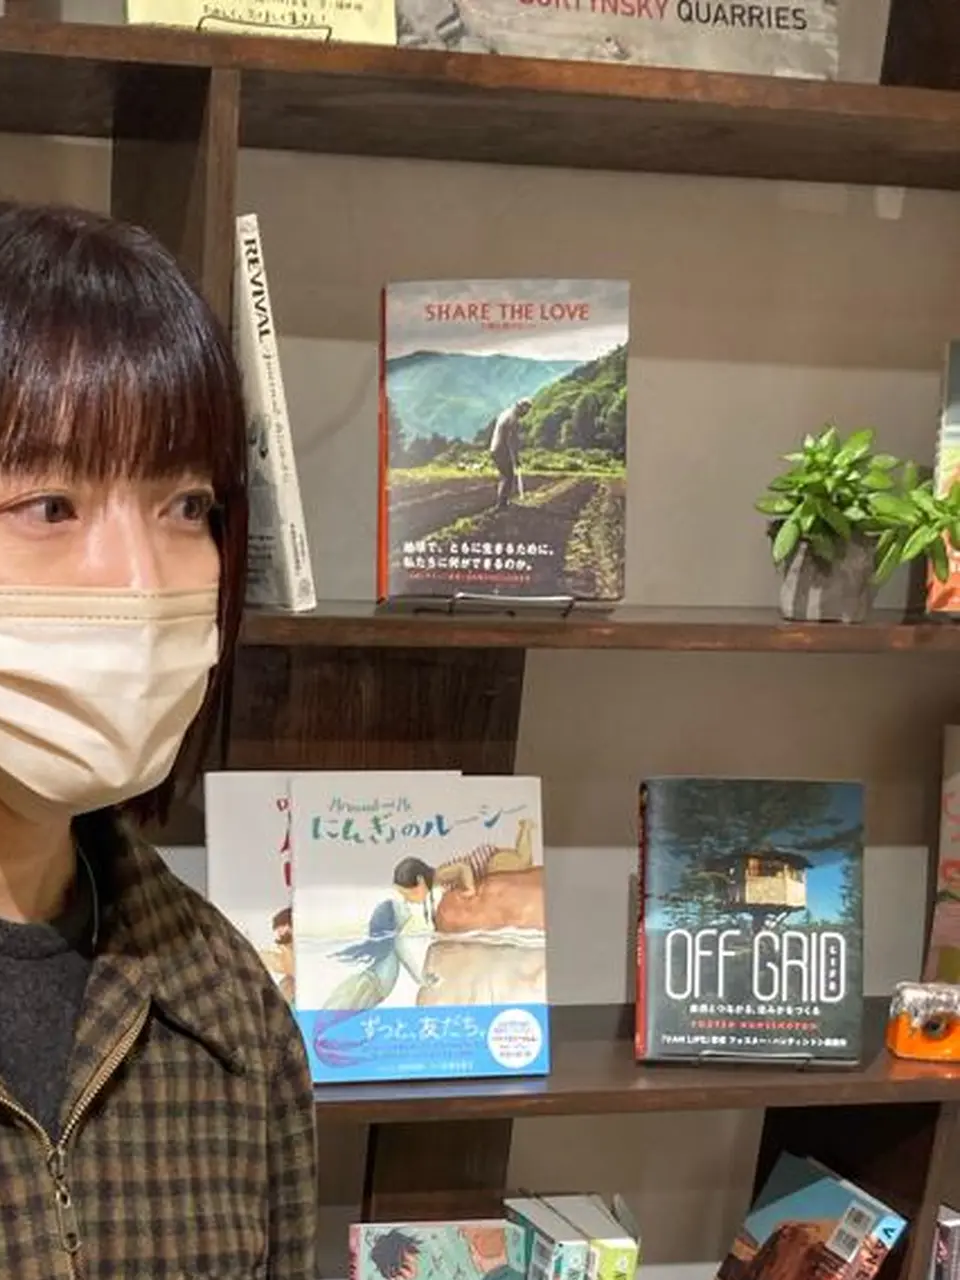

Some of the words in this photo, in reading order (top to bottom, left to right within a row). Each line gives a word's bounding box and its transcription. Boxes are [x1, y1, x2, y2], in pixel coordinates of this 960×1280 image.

[676, 0, 808, 31] QUARRIES
[243, 238, 271, 343] REVIVAL
[424, 302, 491, 321] SHARE
[497, 302, 535, 321] THE
[540, 302, 590, 321] LOVE
[665, 929, 741, 1000] OFF
[752, 930, 846, 1004] GRID
